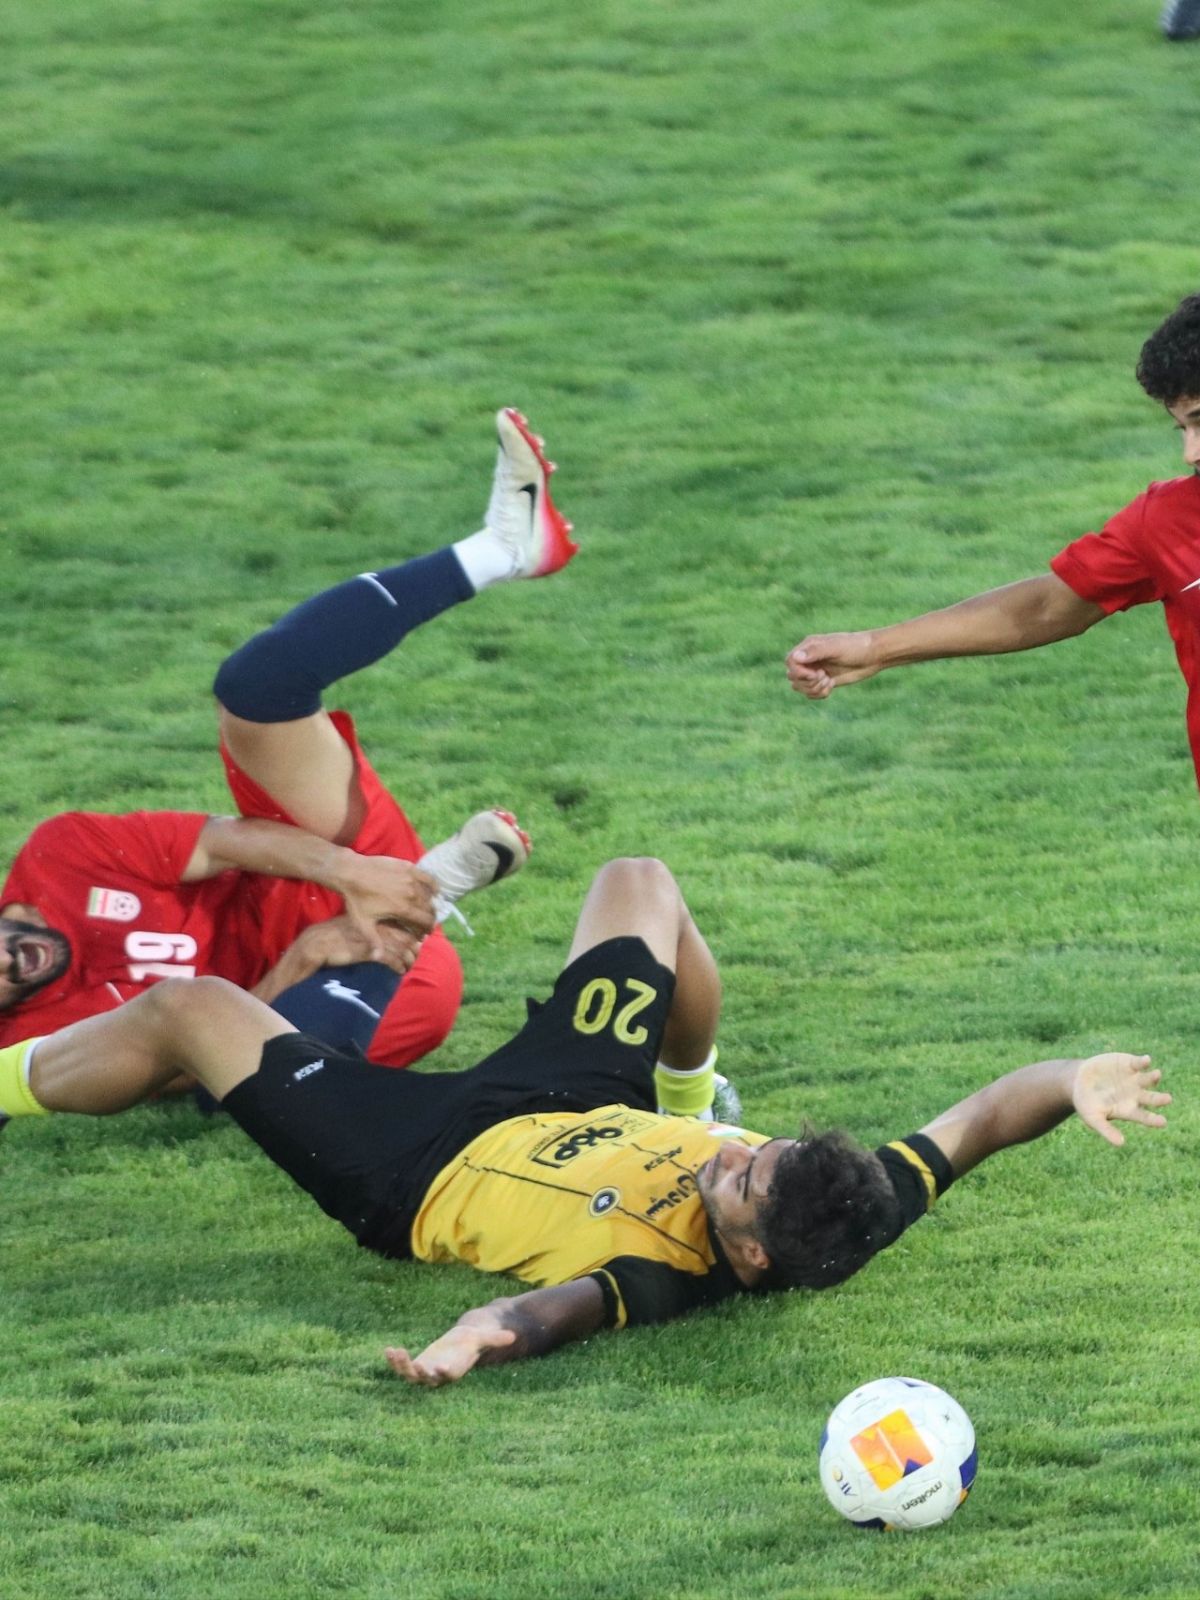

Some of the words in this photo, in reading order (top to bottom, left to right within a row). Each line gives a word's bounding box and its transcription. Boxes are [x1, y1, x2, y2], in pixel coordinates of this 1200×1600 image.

[125, 930, 197, 982] 19
[573, 977, 657, 1045] 20
[901, 1481, 942, 1511] molten
